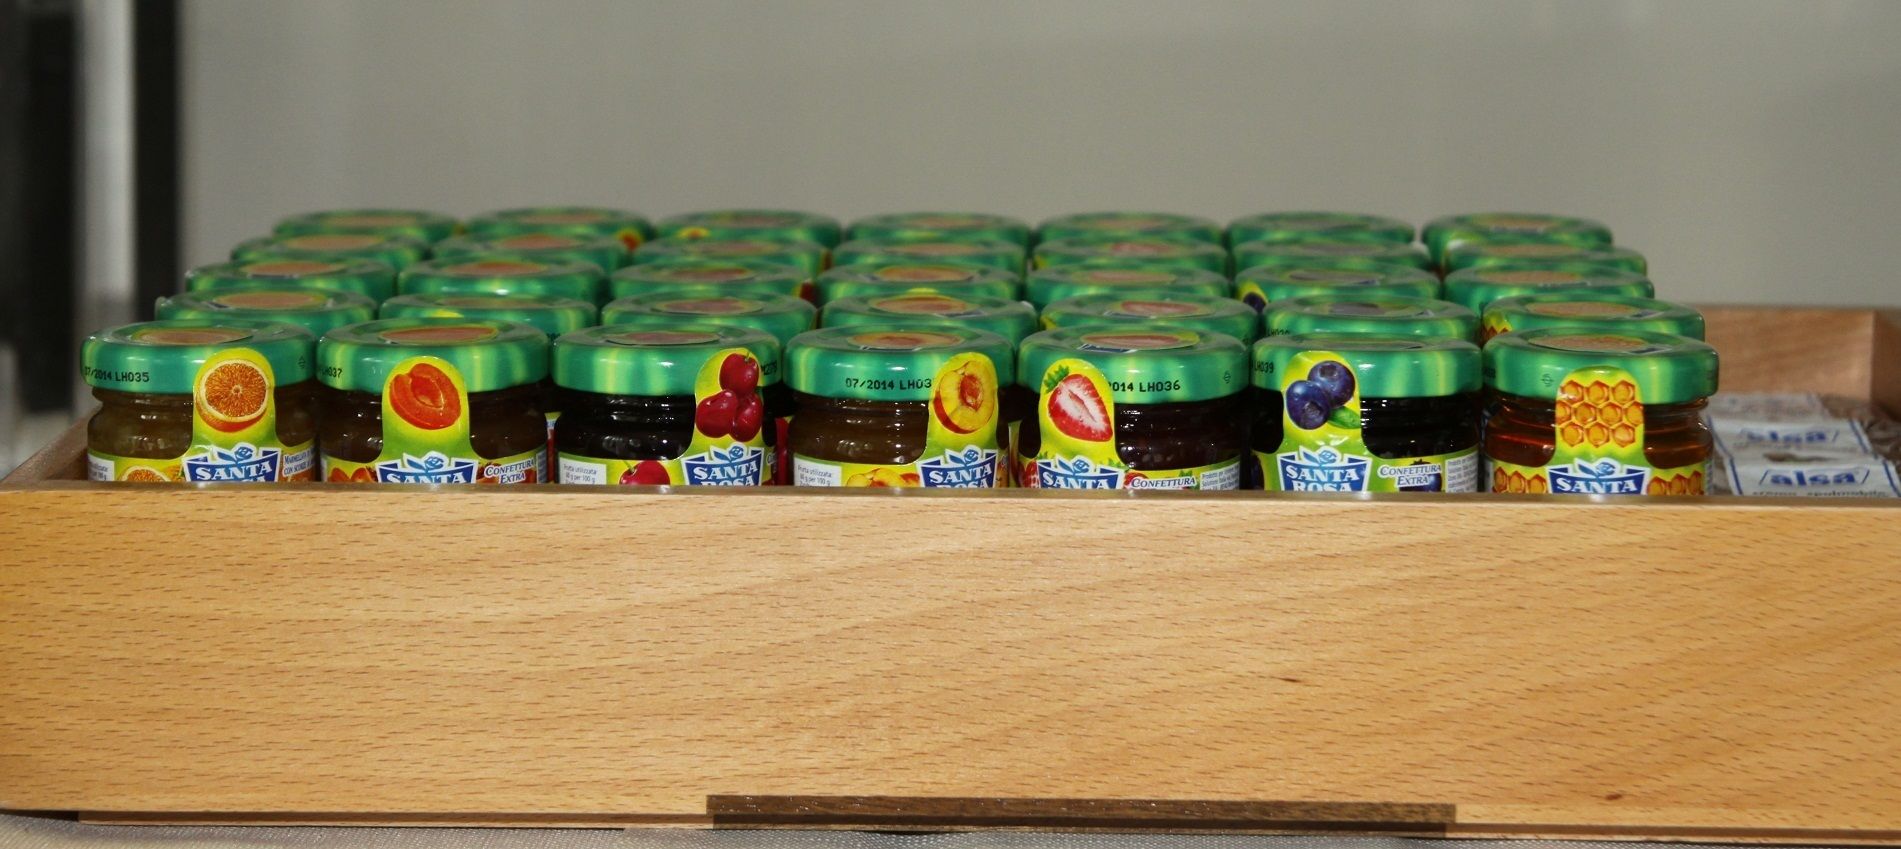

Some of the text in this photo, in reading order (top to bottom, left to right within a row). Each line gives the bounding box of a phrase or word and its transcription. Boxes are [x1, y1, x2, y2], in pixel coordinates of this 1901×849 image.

[114, 371, 150, 382] LH035
[845, 378, 933, 390] 07/2014 LH03
[1139, 380, 1181, 392] LH036
[195, 460, 273, 480] SANTA
[485, 459, 534, 476] CONFETTURA
[693, 460, 758, 480] SANTA
[929, 463, 992, 483] SANTA
[1285, 464, 1360, 482] SANTA
[1380, 464, 1441, 476] CONFETTURA
[386, 471, 468, 483] SANTA
[500, 473, 525, 484] EXTRA
[1042, 471, 1110, 489] SANTA
[1131, 476, 1196, 488] CONFETTURA
[1397, 475, 1429, 486] EXTRA
[1292, 480, 1352, 492] ROSA
[1556, 477, 1638, 493] SANTA
